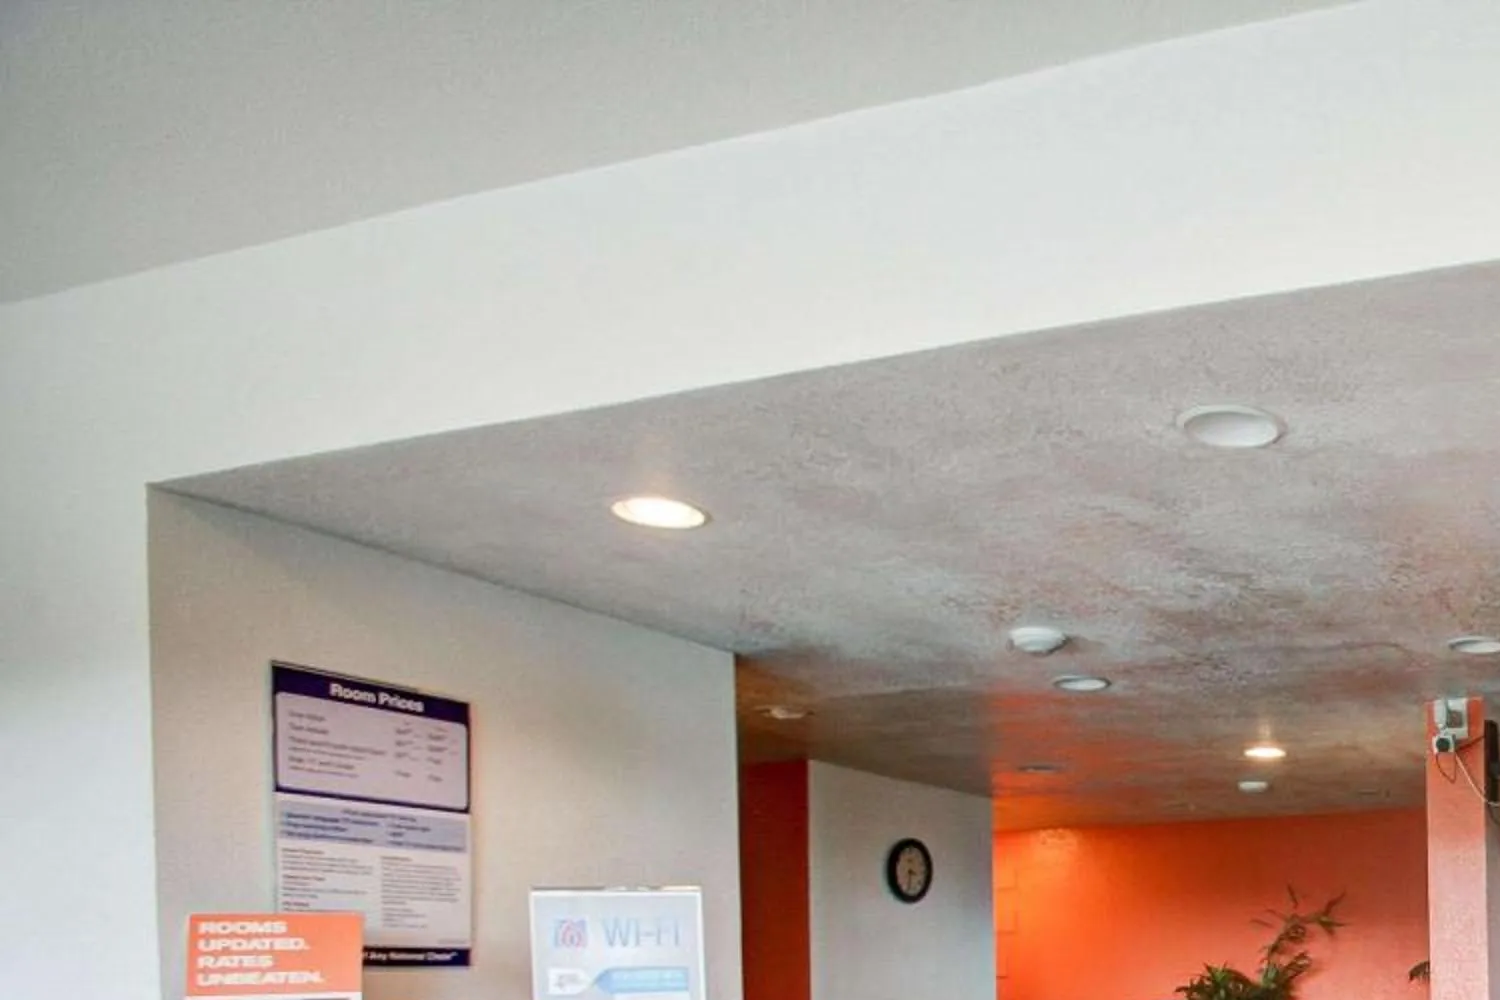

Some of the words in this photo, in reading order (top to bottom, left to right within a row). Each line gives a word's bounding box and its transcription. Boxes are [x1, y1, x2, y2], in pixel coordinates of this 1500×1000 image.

[329, 683, 377, 704] Room
[378, 691, 424, 713] Prices
[197, 921, 288, 934] ROOMS
[603, 917, 681, 947] WI-FI
[197, 937, 310, 951] UPDATED.
[197, 955, 274, 969] RATES
[196, 970, 325, 987] UNBEATEN.
